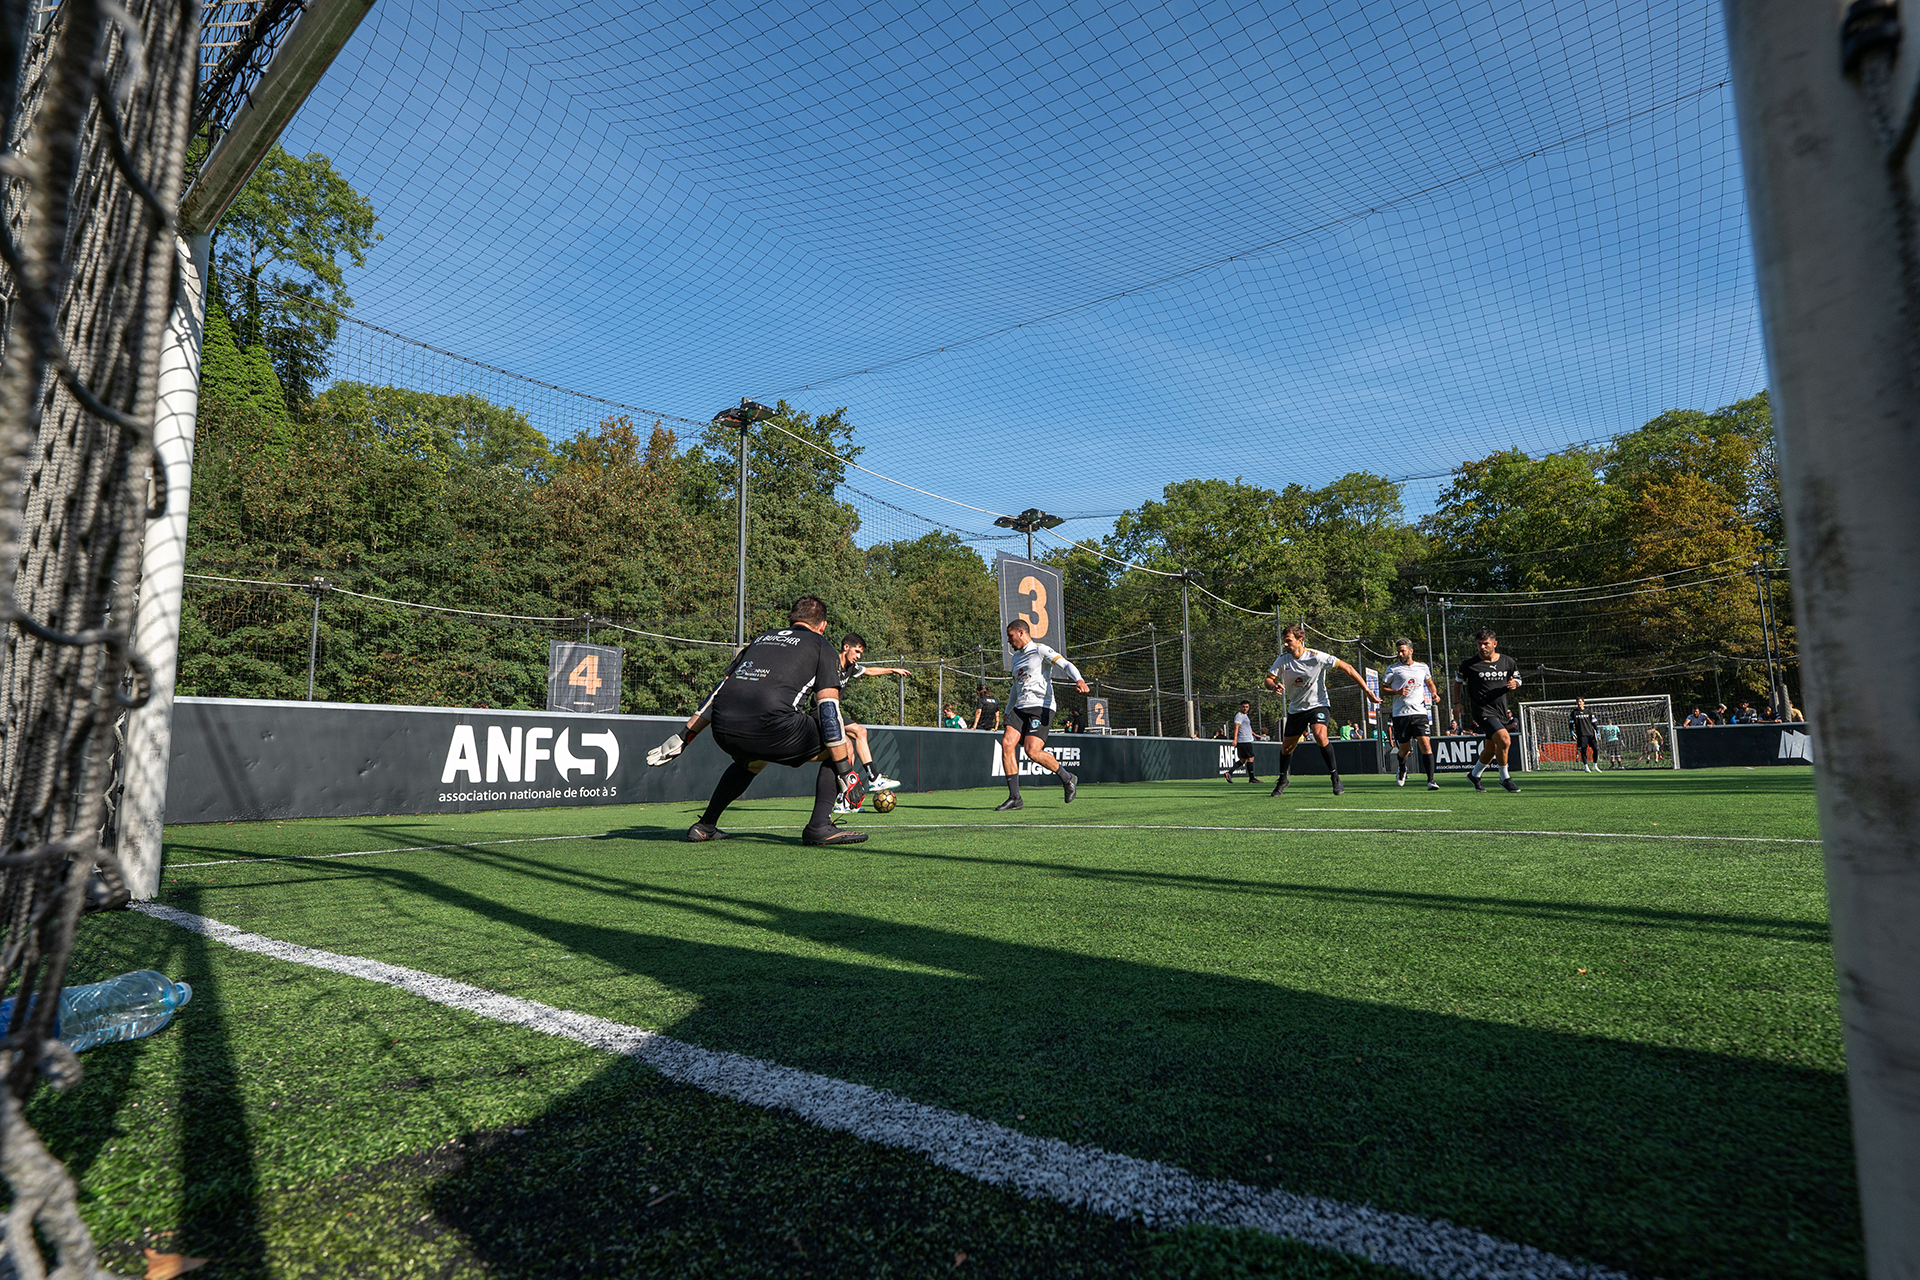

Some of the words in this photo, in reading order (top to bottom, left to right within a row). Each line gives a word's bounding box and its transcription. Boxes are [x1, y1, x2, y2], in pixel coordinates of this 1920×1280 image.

[1018, 575, 1049, 639] 3
[762, 635, 801, 646] BUTCHER
[568, 654, 602, 696] 4
[1094, 702, 1105, 725] 2
[441, 724, 620, 783] ANF5
[1219, 744, 1241, 768] ANF
[1436, 740, 1490, 763] ANF
[1018, 761, 1056, 776] LIGU
[438, 789, 507, 802] association
[509, 787, 562, 800] nationale
[563, 786, 577, 799] de
[579, 785, 600, 798] foot
[602, 785, 609, 797] à
[610, 786, 617, 797] 5
